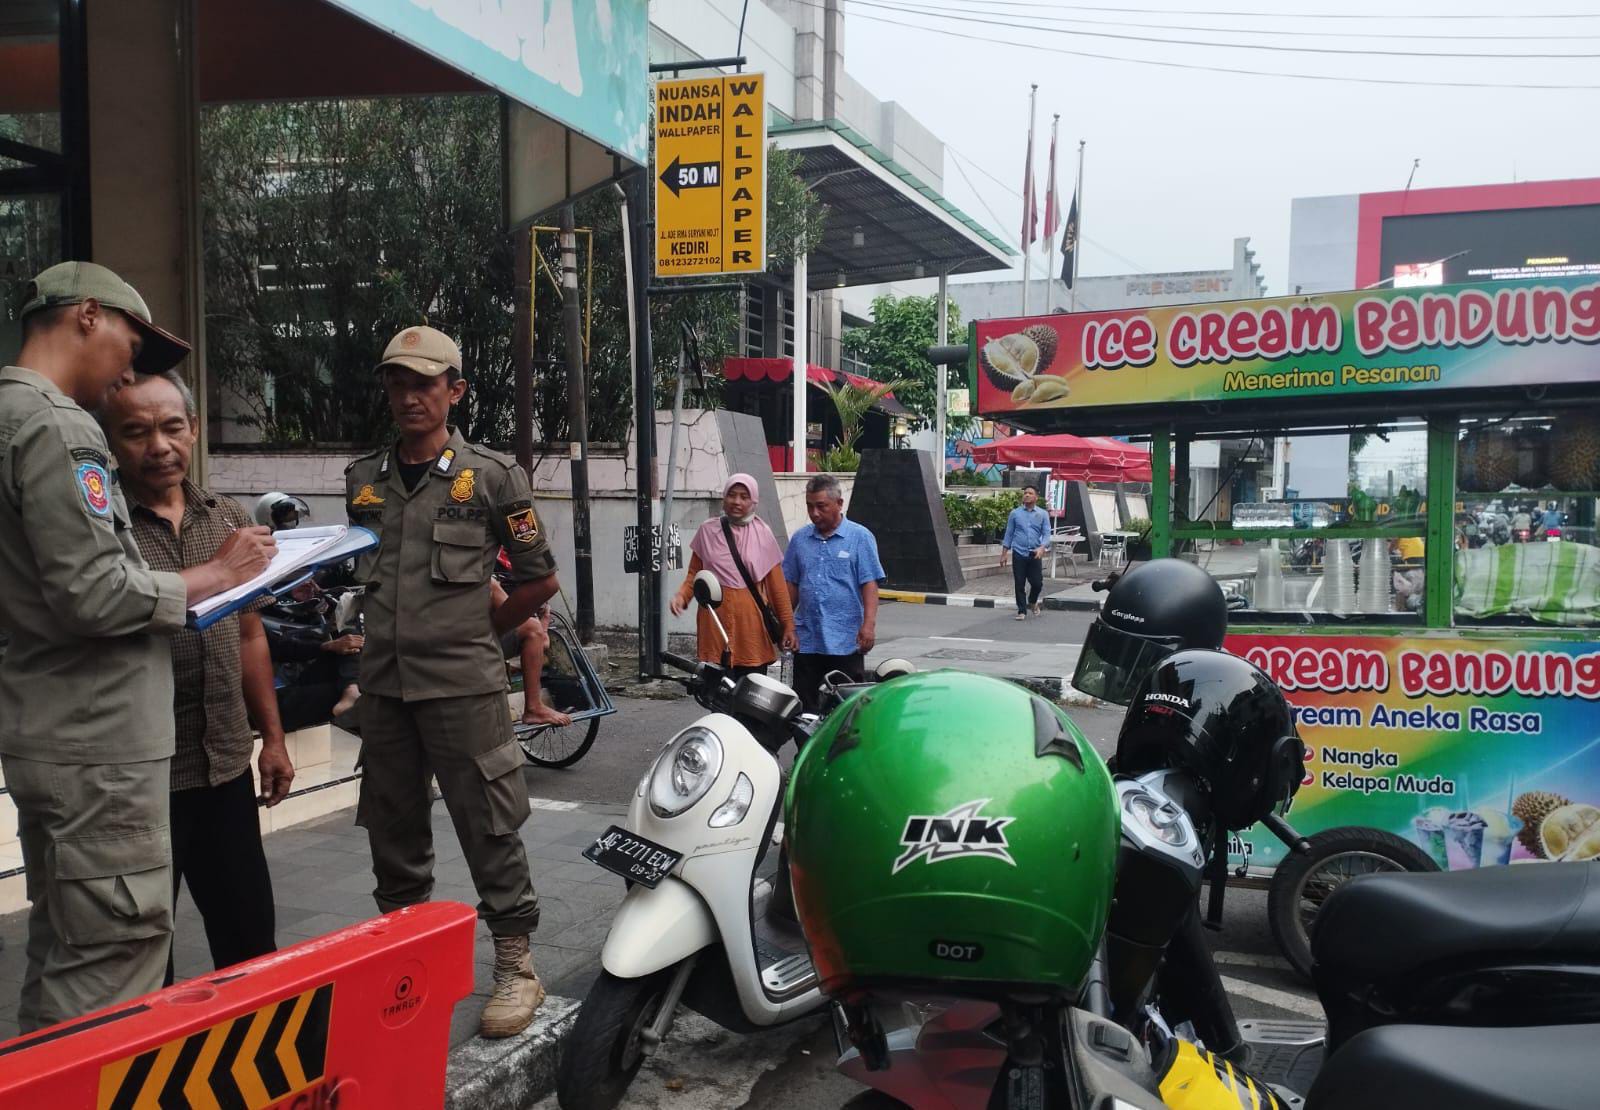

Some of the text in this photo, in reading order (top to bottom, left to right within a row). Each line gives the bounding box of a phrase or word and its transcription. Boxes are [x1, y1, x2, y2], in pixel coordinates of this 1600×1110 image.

[659, 84, 721, 102] NUANSA
[659, 103, 721, 123] INDAH
[658, 125, 720, 138] WALLPAPER
[678, 166, 718, 186] 50 M
[729, 81, 758, 264] WALLPAPER
[671, 241, 709, 255] KEDIRI
[659, 256, 721, 267] 08123272102
[1126, 278, 1233, 296] PRESIDENT
[1223, 364, 1440, 392] Menerima Pesanan
[1144, 693, 1191, 708] HONDA
[1288, 704, 1541, 733] ream Aneka Rasa
[1322, 747, 1398, 769] Nangka
[1323, 771, 1453, 794] Kelapa Muda
[899, 814, 1017, 850] INK
[616, 838, 652, 861] 2271
[646, 850, 677, 871] ECW
[936, 943, 976, 959] DOT
